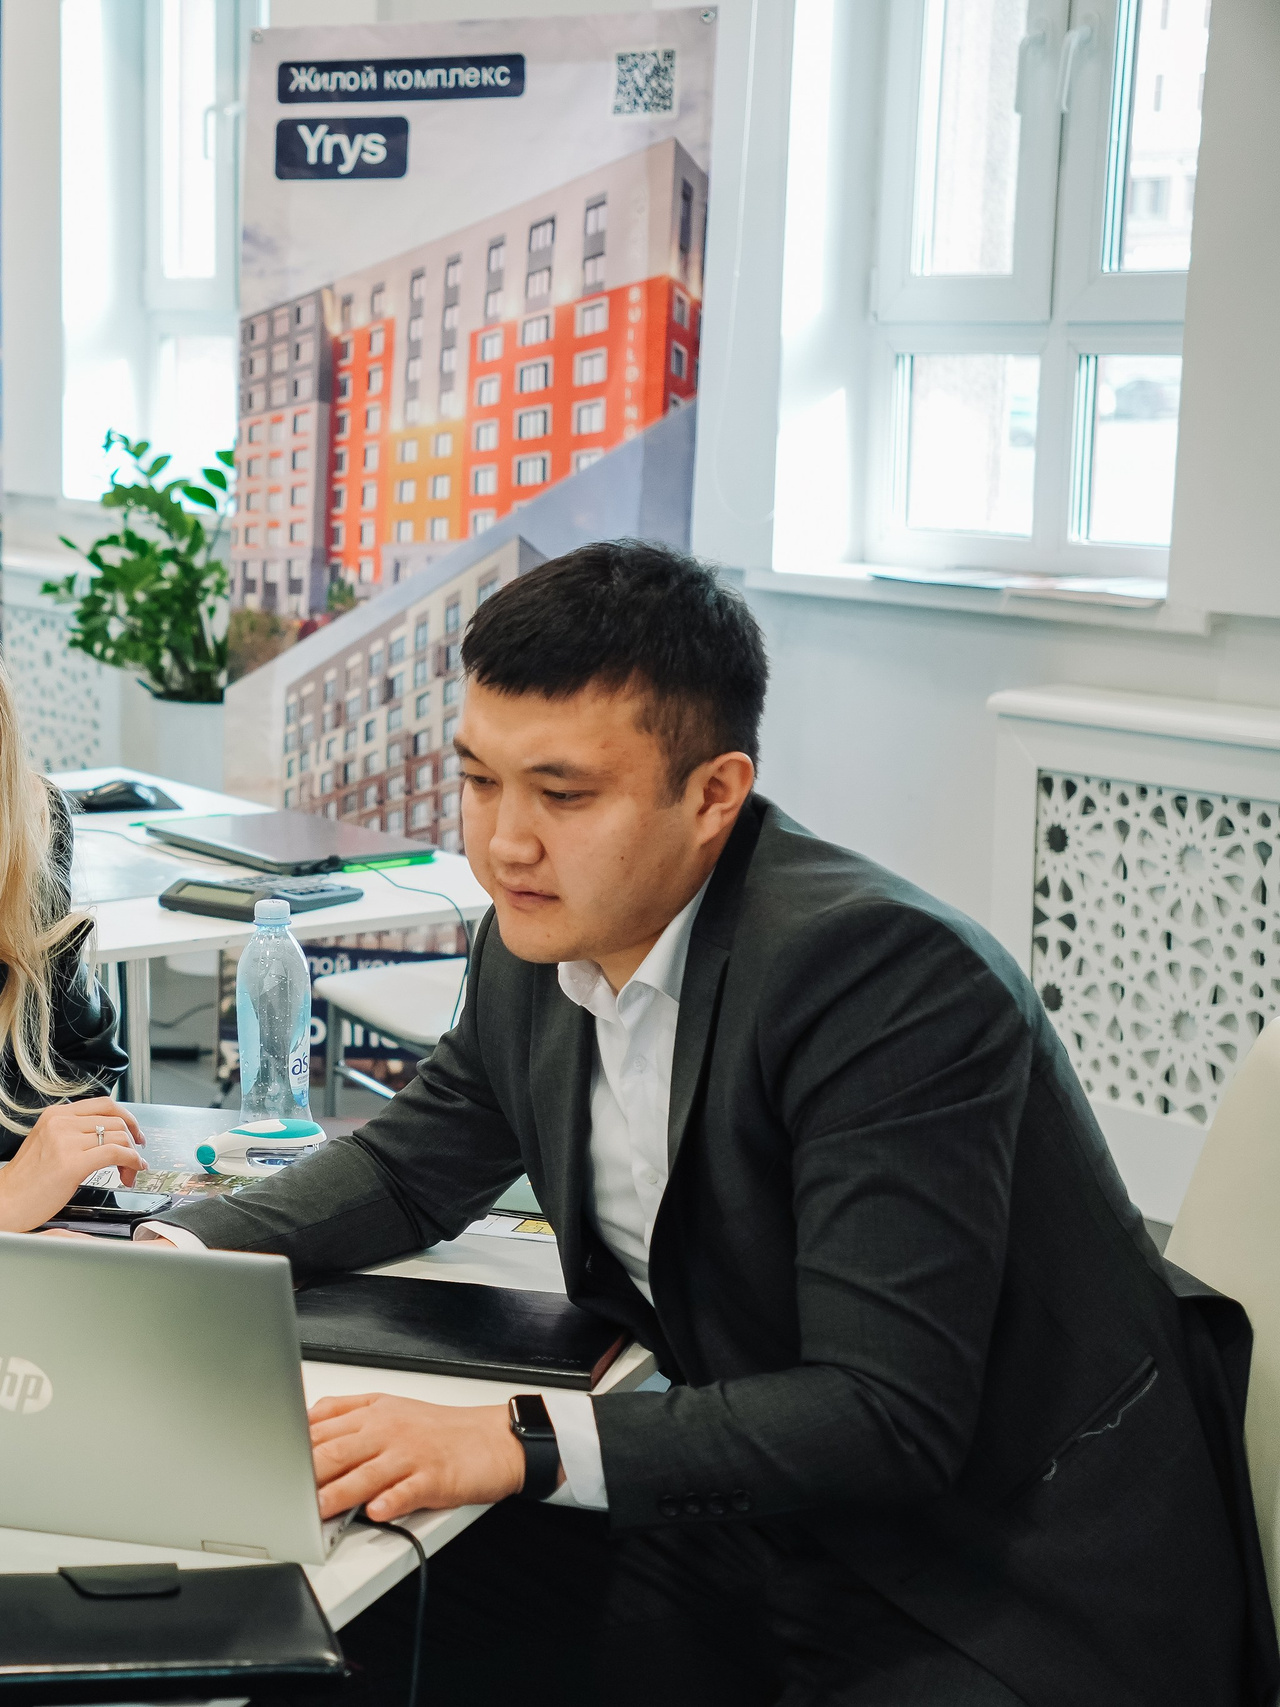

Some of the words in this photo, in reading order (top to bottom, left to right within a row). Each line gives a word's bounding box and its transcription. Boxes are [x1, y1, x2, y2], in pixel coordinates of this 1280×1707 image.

[289, 66, 377, 93] Жилой
[384, 65, 511, 91] комплекс
[297, 124, 388, 175] Yrys
